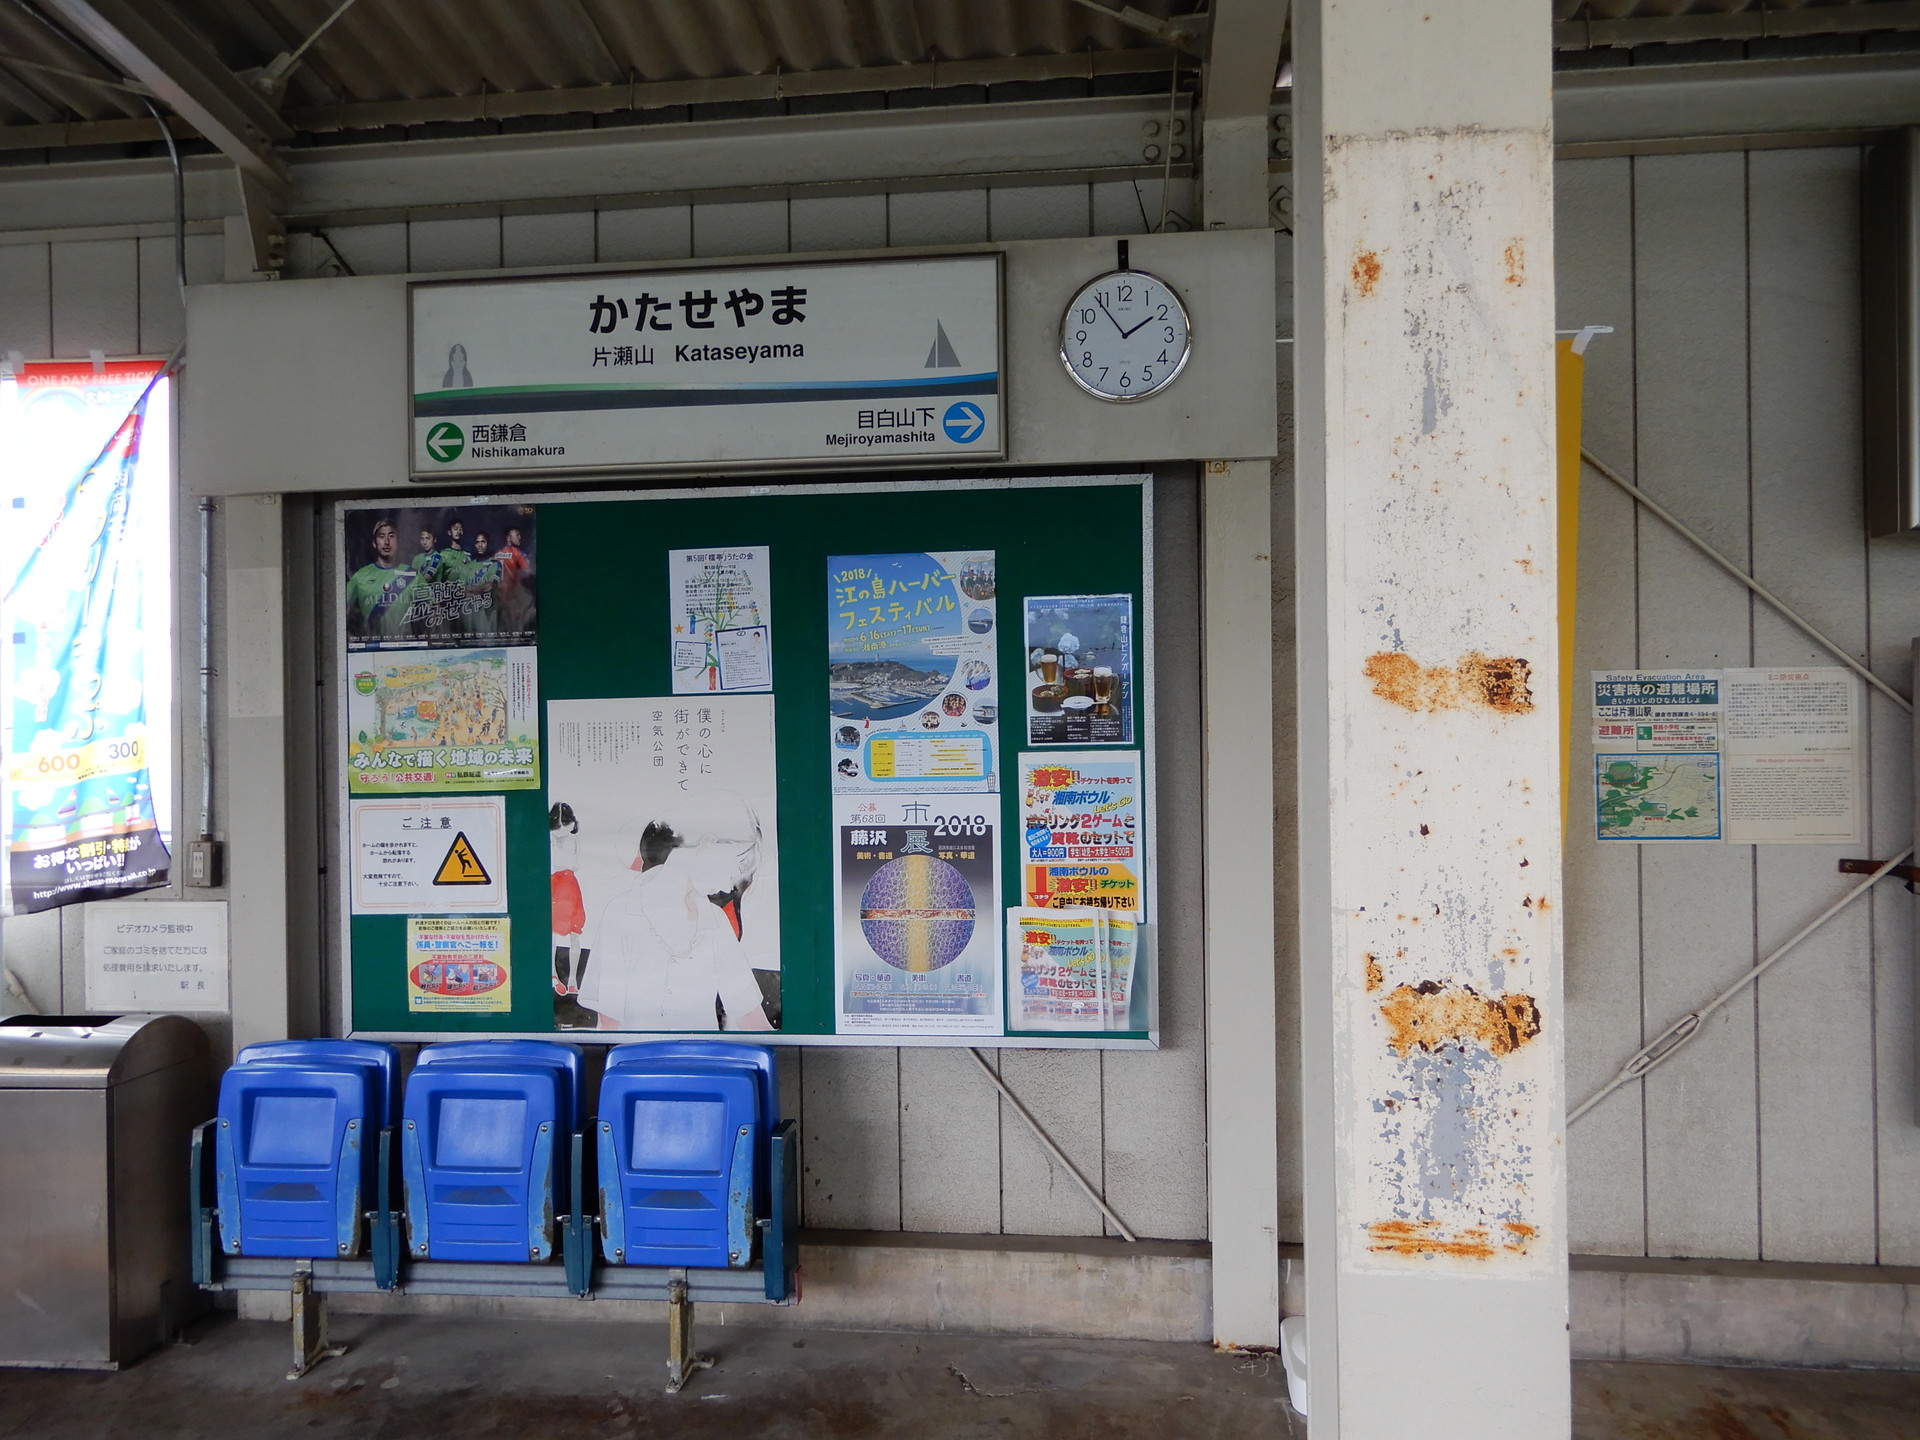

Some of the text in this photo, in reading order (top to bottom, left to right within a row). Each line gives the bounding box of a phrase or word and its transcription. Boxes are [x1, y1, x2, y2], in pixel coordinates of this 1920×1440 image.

[1097, 292, 1110, 308] 11
[1116, 285, 1133, 302] 12
[588, 285, 808, 335] かたせやま
[1080, 308, 1096, 324] 10
[1156, 304, 1169, 320] 2
[1075, 330, 1087, 346] 9
[1163, 326, 1175, 343] 3
[592, 345, 654, 368] 片瀬山
[674, 340, 805, 363] Kataseyama
[1082, 351, 1093, 368] 8
[1156, 349, 1169, 365] 4
[27, 375, 62, 387] ONE
[65, 374, 90, 386] DAY
[93, 374, 122, 385] FREE
[1098, 367, 1109, 382] 7
[1119, 371, 1131, 387] 6
[1141, 365, 1153, 381] 5
[856, 407, 936, 430] 目白山下
[471, 423, 528, 444] 西鎌倉
[824, 430, 936, 447] Mejiroyamashita
[470, 445, 566, 459] Nishikamakura
[840, 568, 865, 582] 2018
[834, 569, 957, 607] 江の島ハーバー
[839, 594, 956, 631] フェスティバル
[1605, 673, 1706, 682] Safety Evacuation Area
[1597, 682, 1717, 697] 災害時の避難場所
[1598, 706, 1652, 718] ここは片瀬山駅
[651, 710, 665, 767] 空気公団
[1598, 725, 1634, 736] 避難所
[696, 707, 713, 775] 僕の心に
[108, 740, 139, 760] 300
[673, 709, 690, 791] 街ができて
[38, 753, 81, 773] 600
[352, 747, 534, 770] みんなで描く地域の未来
[850, 813, 886, 824] 第68回
[933, 815, 987, 837] 2018
[850, 829, 888, 846] 藤沢
[1048, 866, 1109, 877] 湘南ボウルの
[1100, 880, 1135, 890] チケット
[117, 924, 194, 934] ビデオカメラ監視中
[103, 946, 208, 955] ご家庭のゴミを捨てた方には
